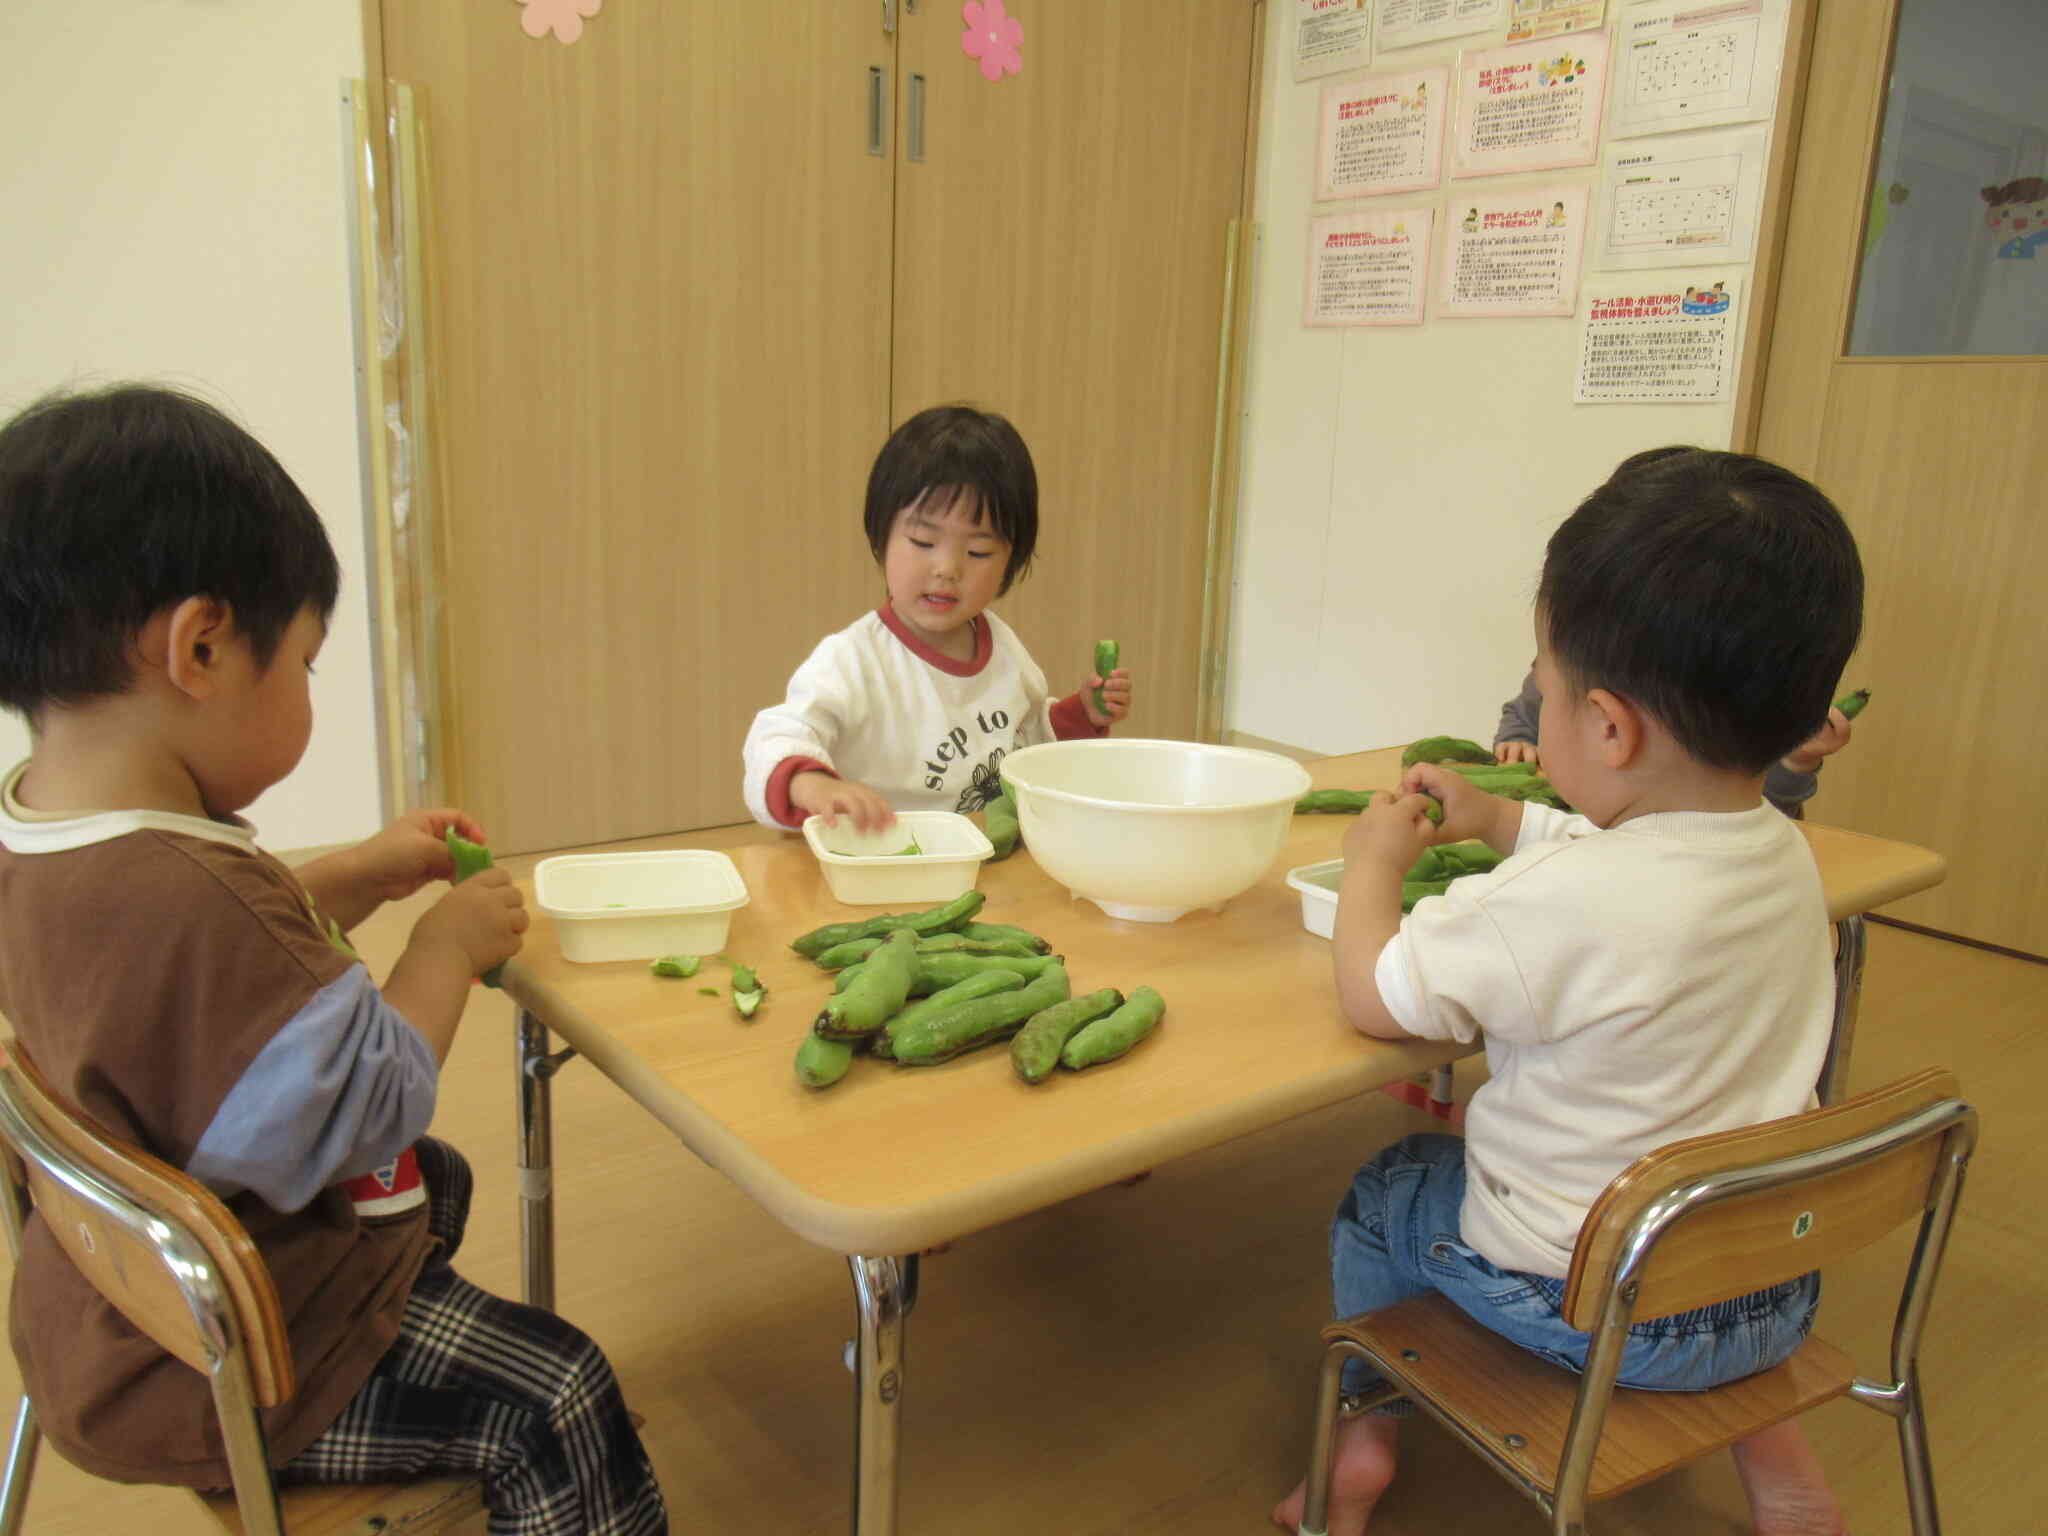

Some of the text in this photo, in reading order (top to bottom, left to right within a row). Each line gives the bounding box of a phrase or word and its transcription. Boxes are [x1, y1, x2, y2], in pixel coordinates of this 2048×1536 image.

[1592, 295, 1680, 308] プール活動・水遊び時の
[924, 710, 1008, 792] step to
